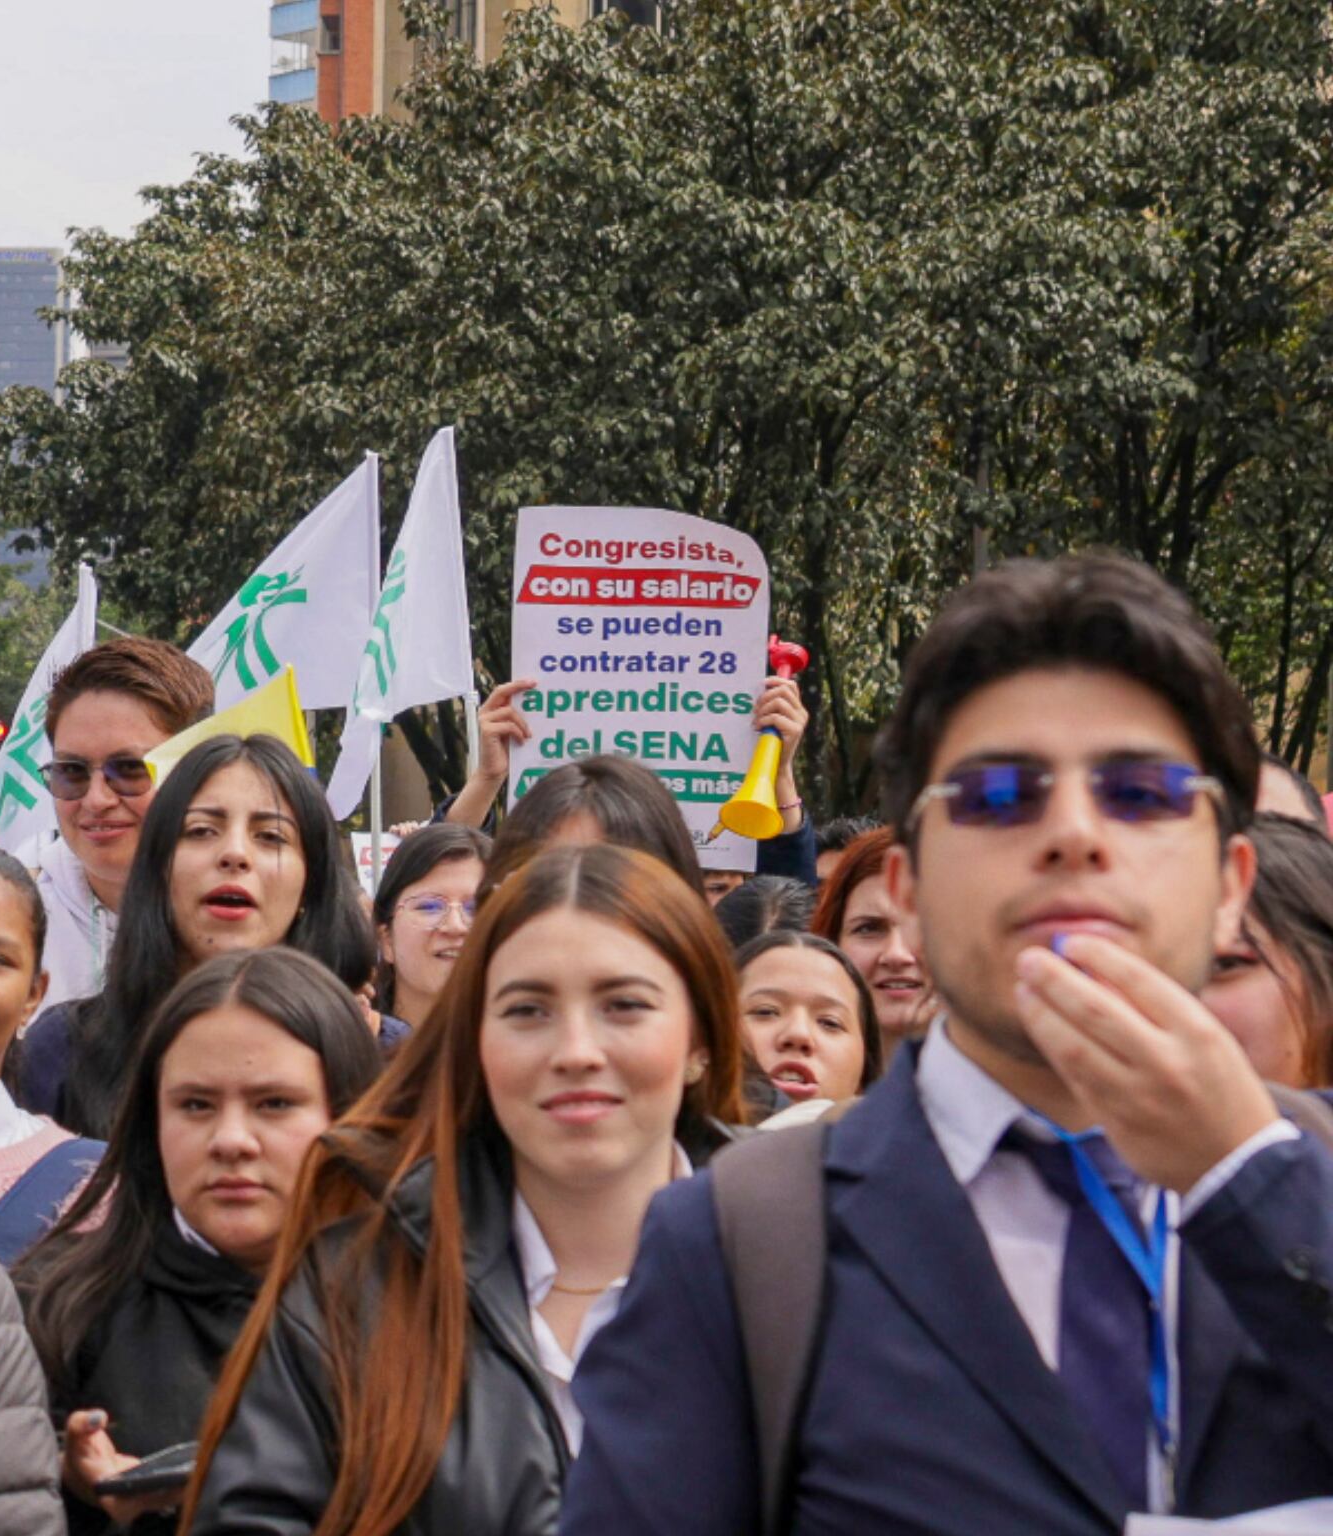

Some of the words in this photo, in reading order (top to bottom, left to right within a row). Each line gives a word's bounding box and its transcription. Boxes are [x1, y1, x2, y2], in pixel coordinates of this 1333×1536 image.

[539, 532, 744, 569] Congresista,
[529, 576, 590, 598] con
[596, 577, 635, 599] su
[640, 573, 754, 602] salario
[557, 615, 594, 635] se
[602, 611, 723, 641] pueden
[539, 650, 690, 673] contratar
[698, 651, 738, 675] 28
[521, 681, 754, 719] aprendices
[539, 728, 602, 760] del
[613, 730, 731, 763] SENA
